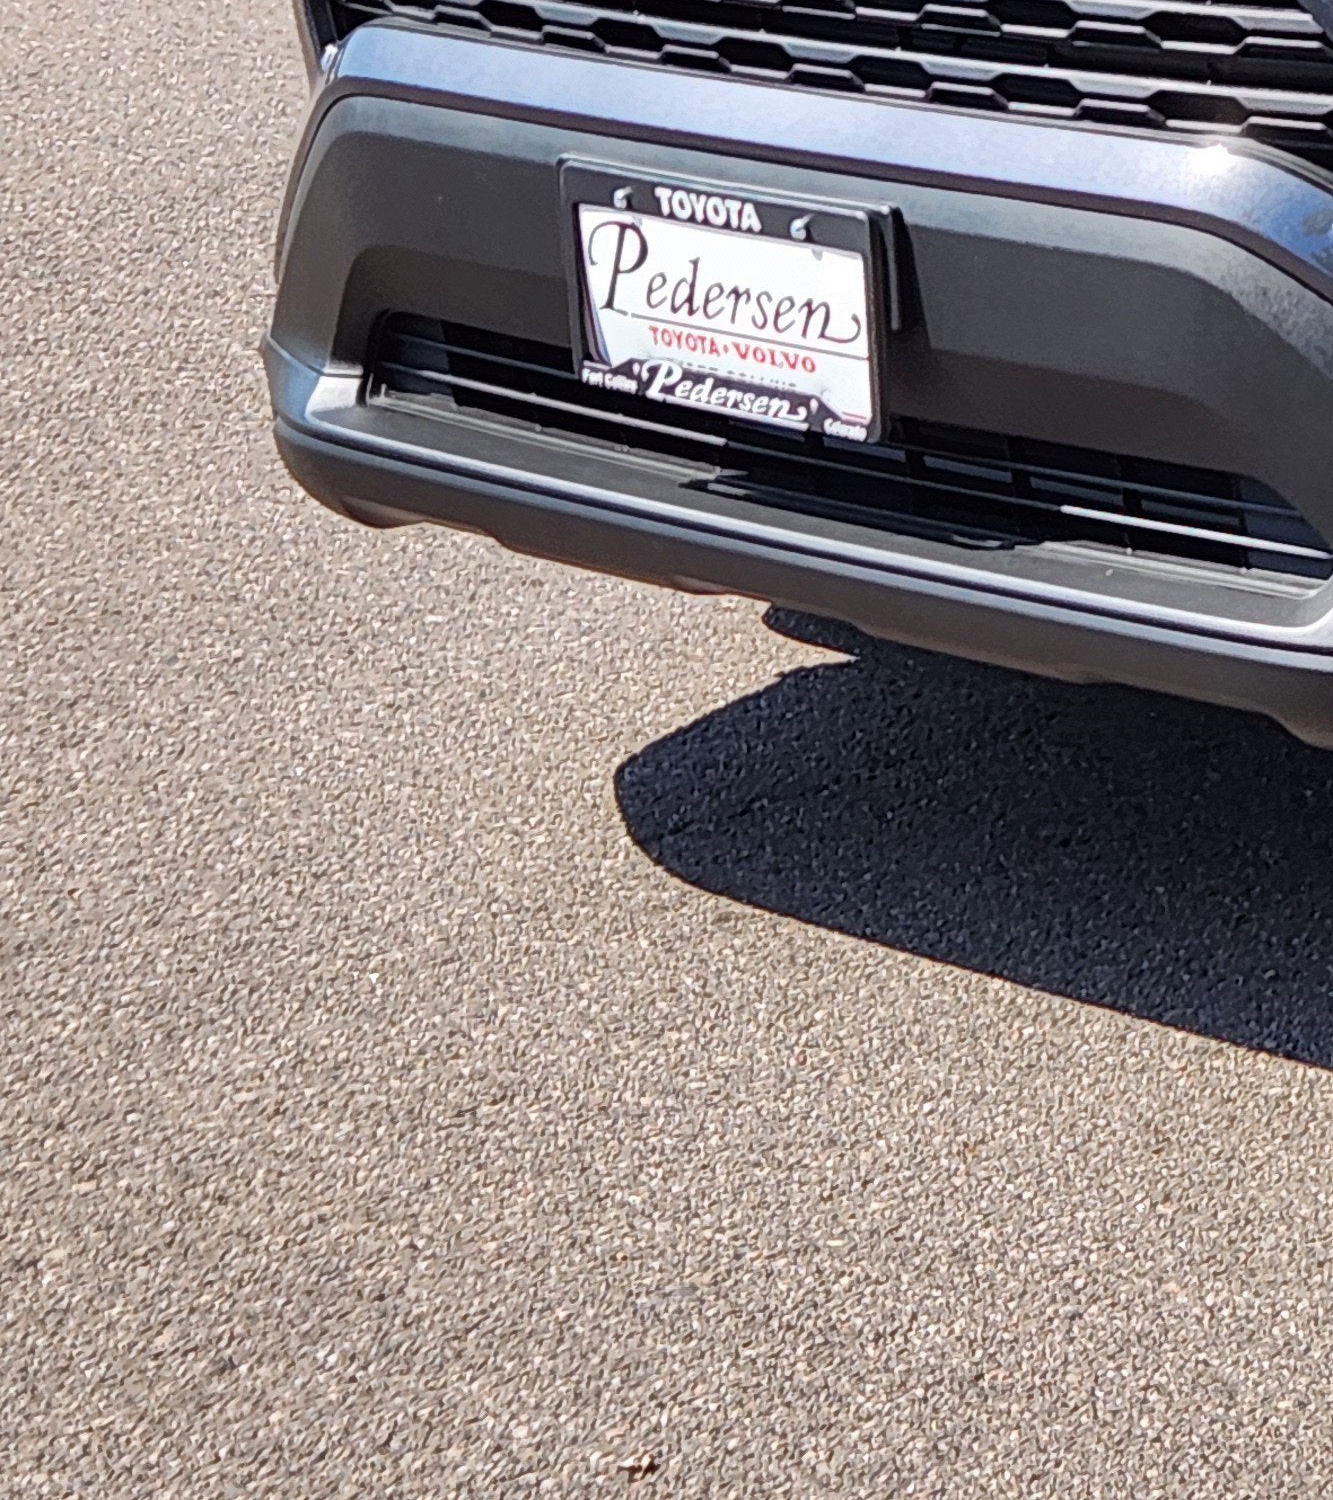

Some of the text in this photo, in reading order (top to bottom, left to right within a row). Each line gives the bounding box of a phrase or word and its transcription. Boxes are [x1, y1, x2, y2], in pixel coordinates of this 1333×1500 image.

[654, 186, 762, 234] TOYOTA
[588, 220, 861, 344] Pedersen
[641, 358, 808, 422] Pedersen
